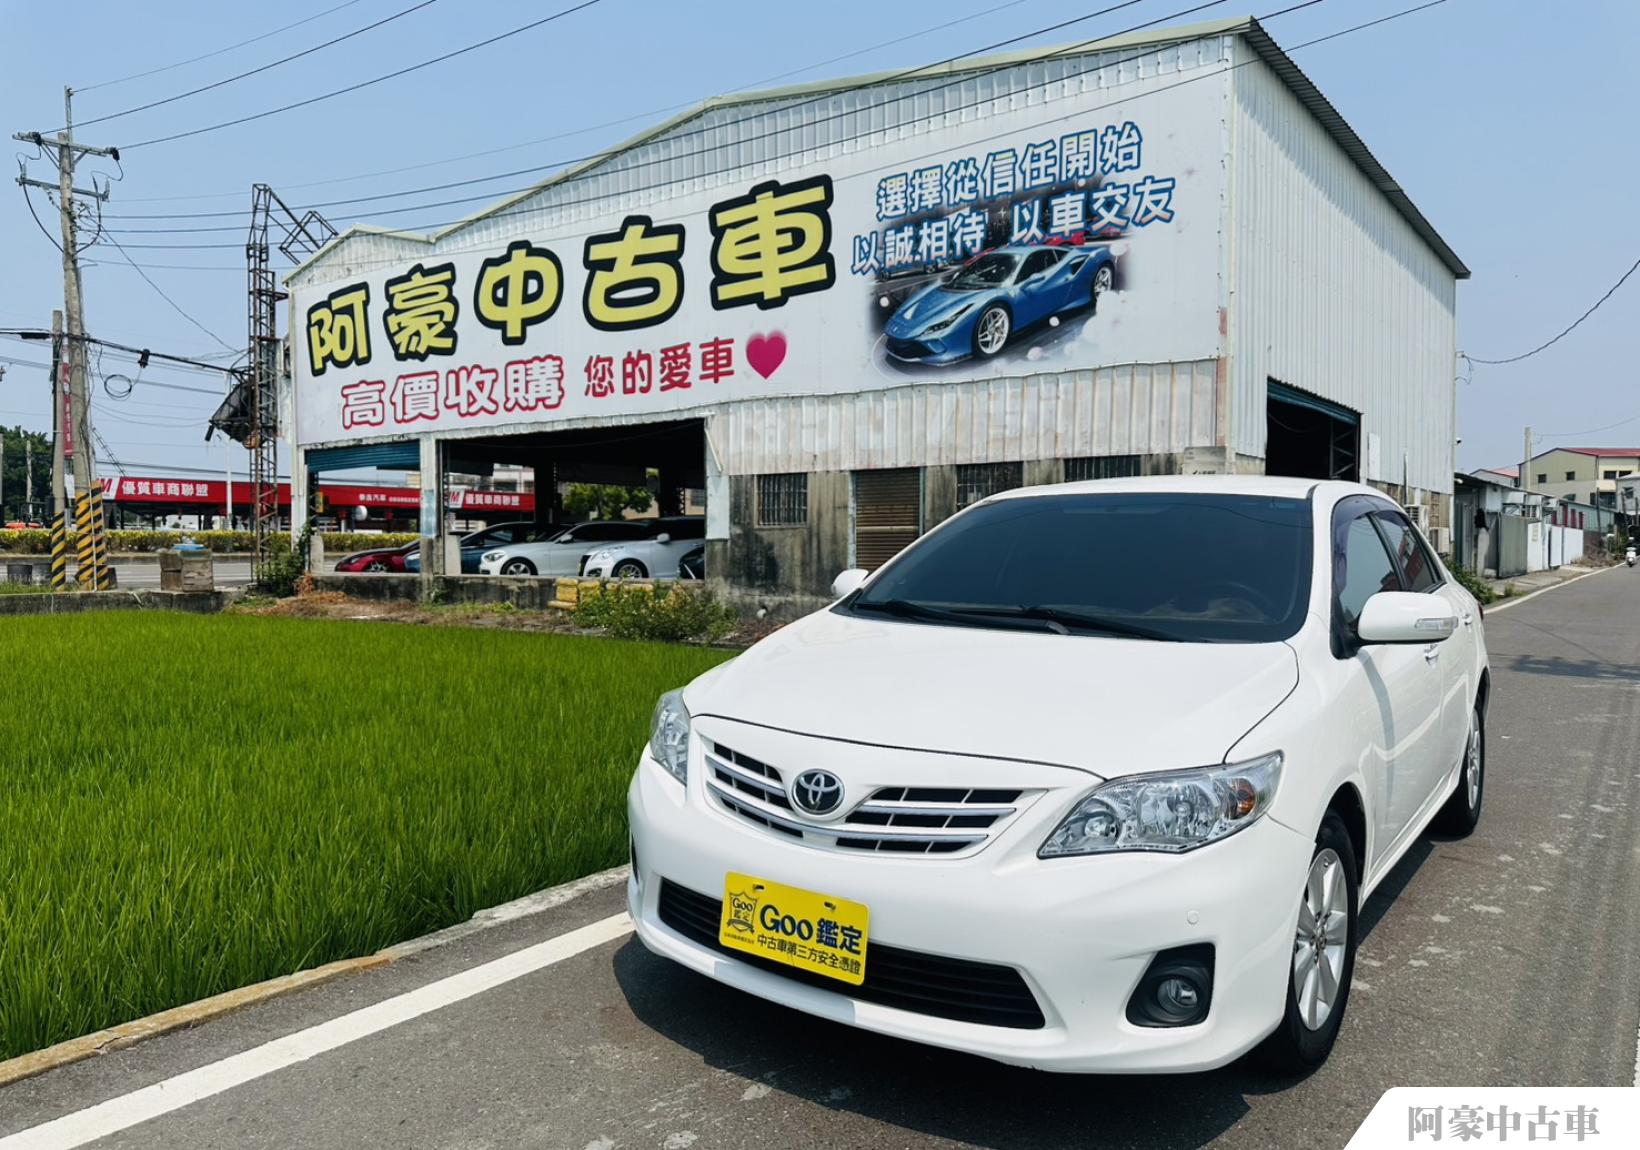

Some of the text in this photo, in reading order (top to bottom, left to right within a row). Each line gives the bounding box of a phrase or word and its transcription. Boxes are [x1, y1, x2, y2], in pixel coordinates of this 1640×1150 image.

[876, 122, 1142, 221] 選擇從信任開始
[307, 174, 835, 376] 阿豪中古車
[851, 176, 1176, 276] 以誠相待 以車交友
[341, 336, 735, 430] 高價收購 您的愛車
[760, 904, 862, 955] Goo 鑑定
